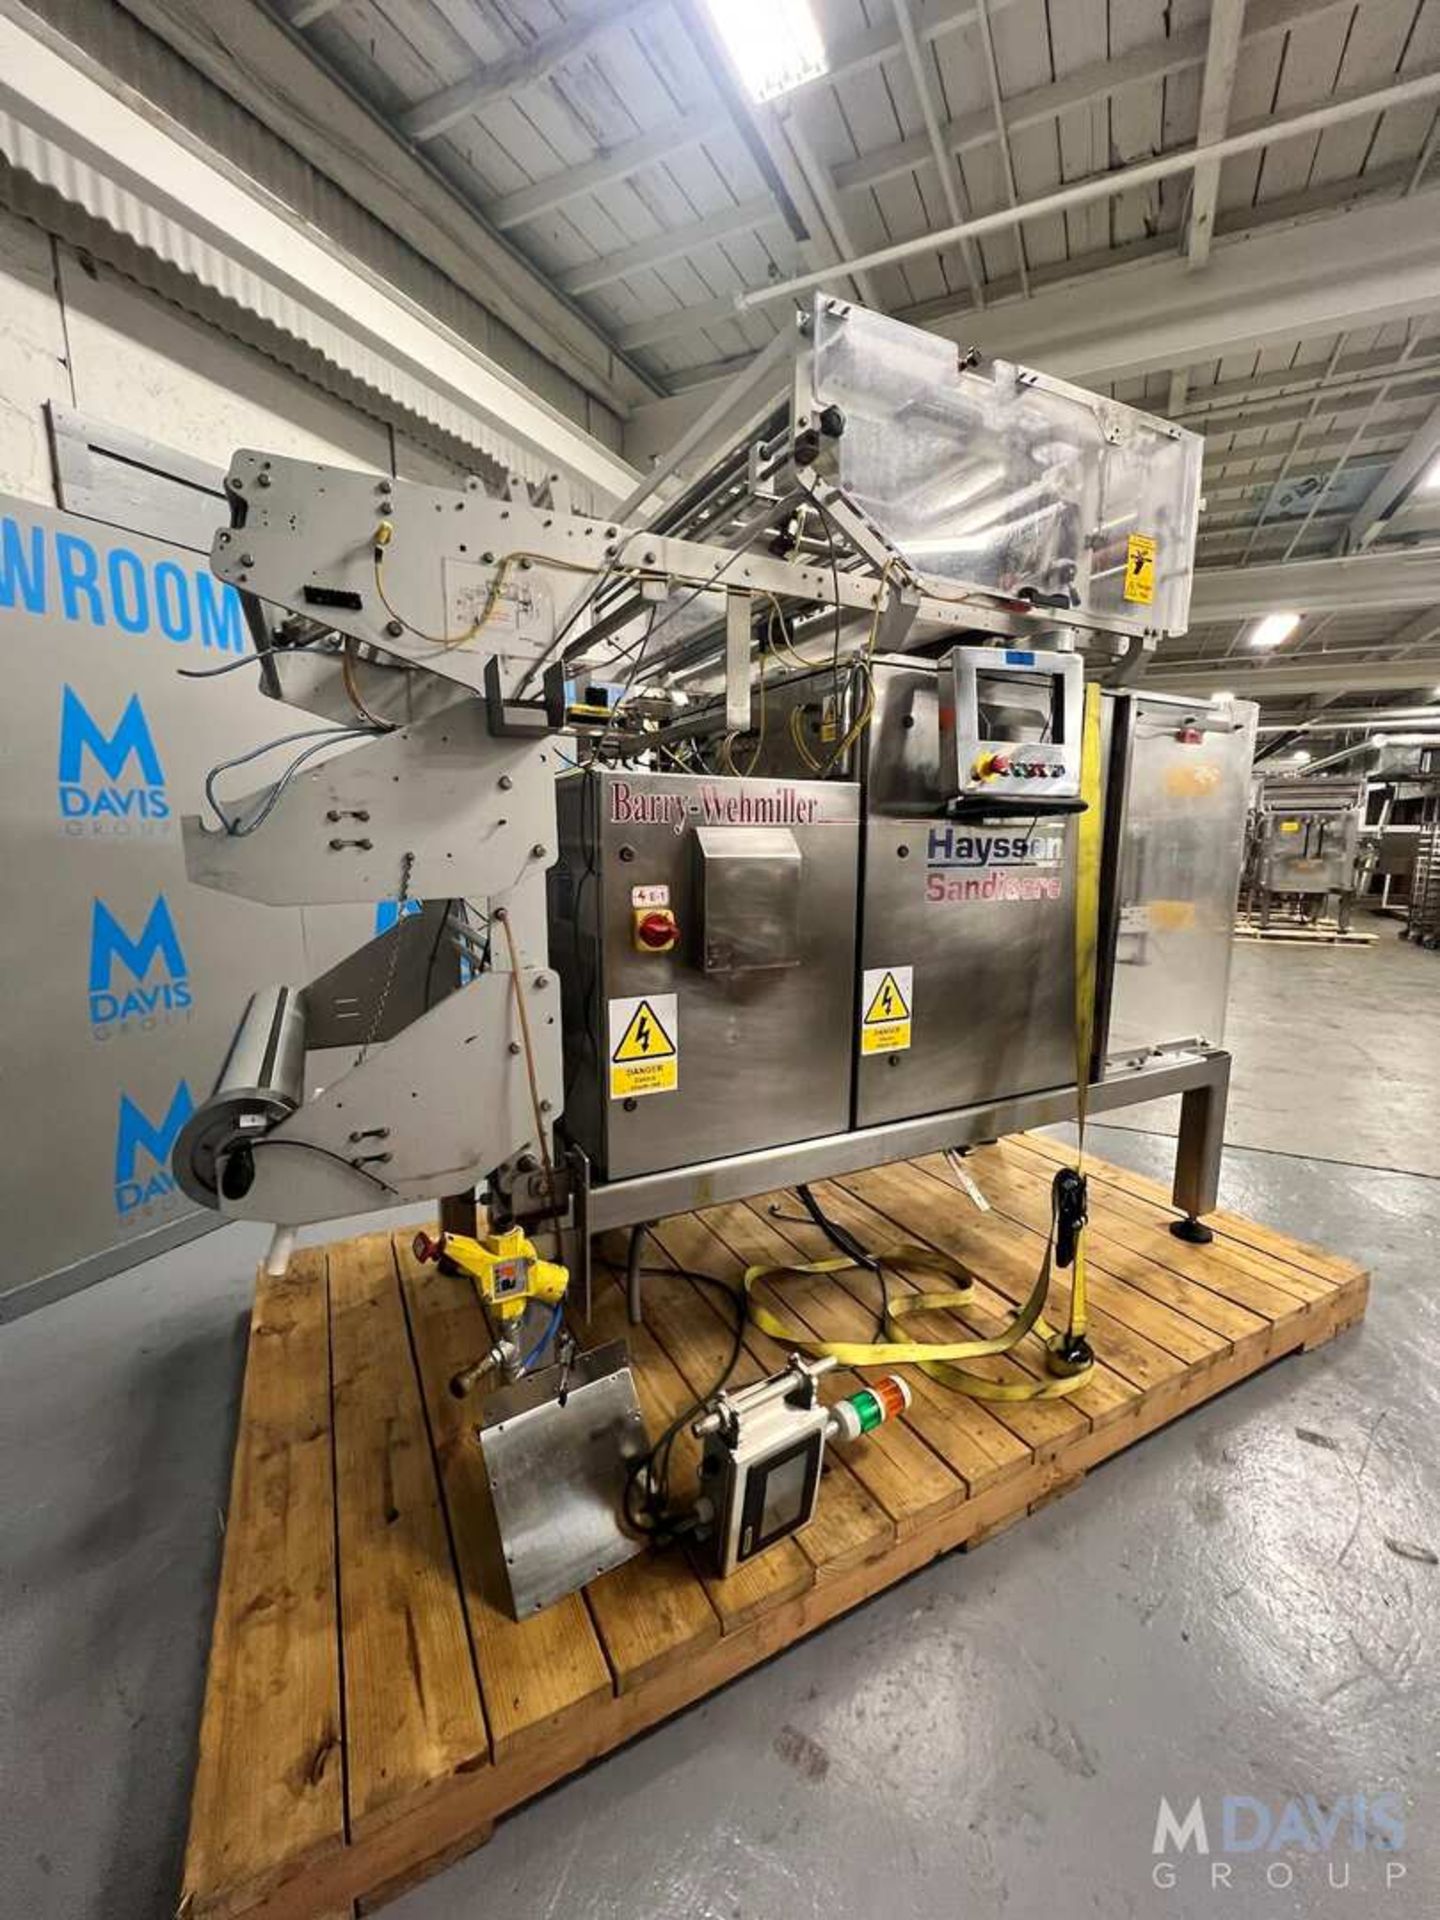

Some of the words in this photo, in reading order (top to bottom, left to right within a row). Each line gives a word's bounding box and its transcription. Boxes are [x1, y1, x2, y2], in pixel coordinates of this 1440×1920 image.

[59, 682, 166, 786] M
[59, 785, 170, 819] DAVIS
[611, 781, 818, 835] Barry-Wehmiller
[89, 894, 188, 991] M
[89, 980, 193, 1024] DAVIS
